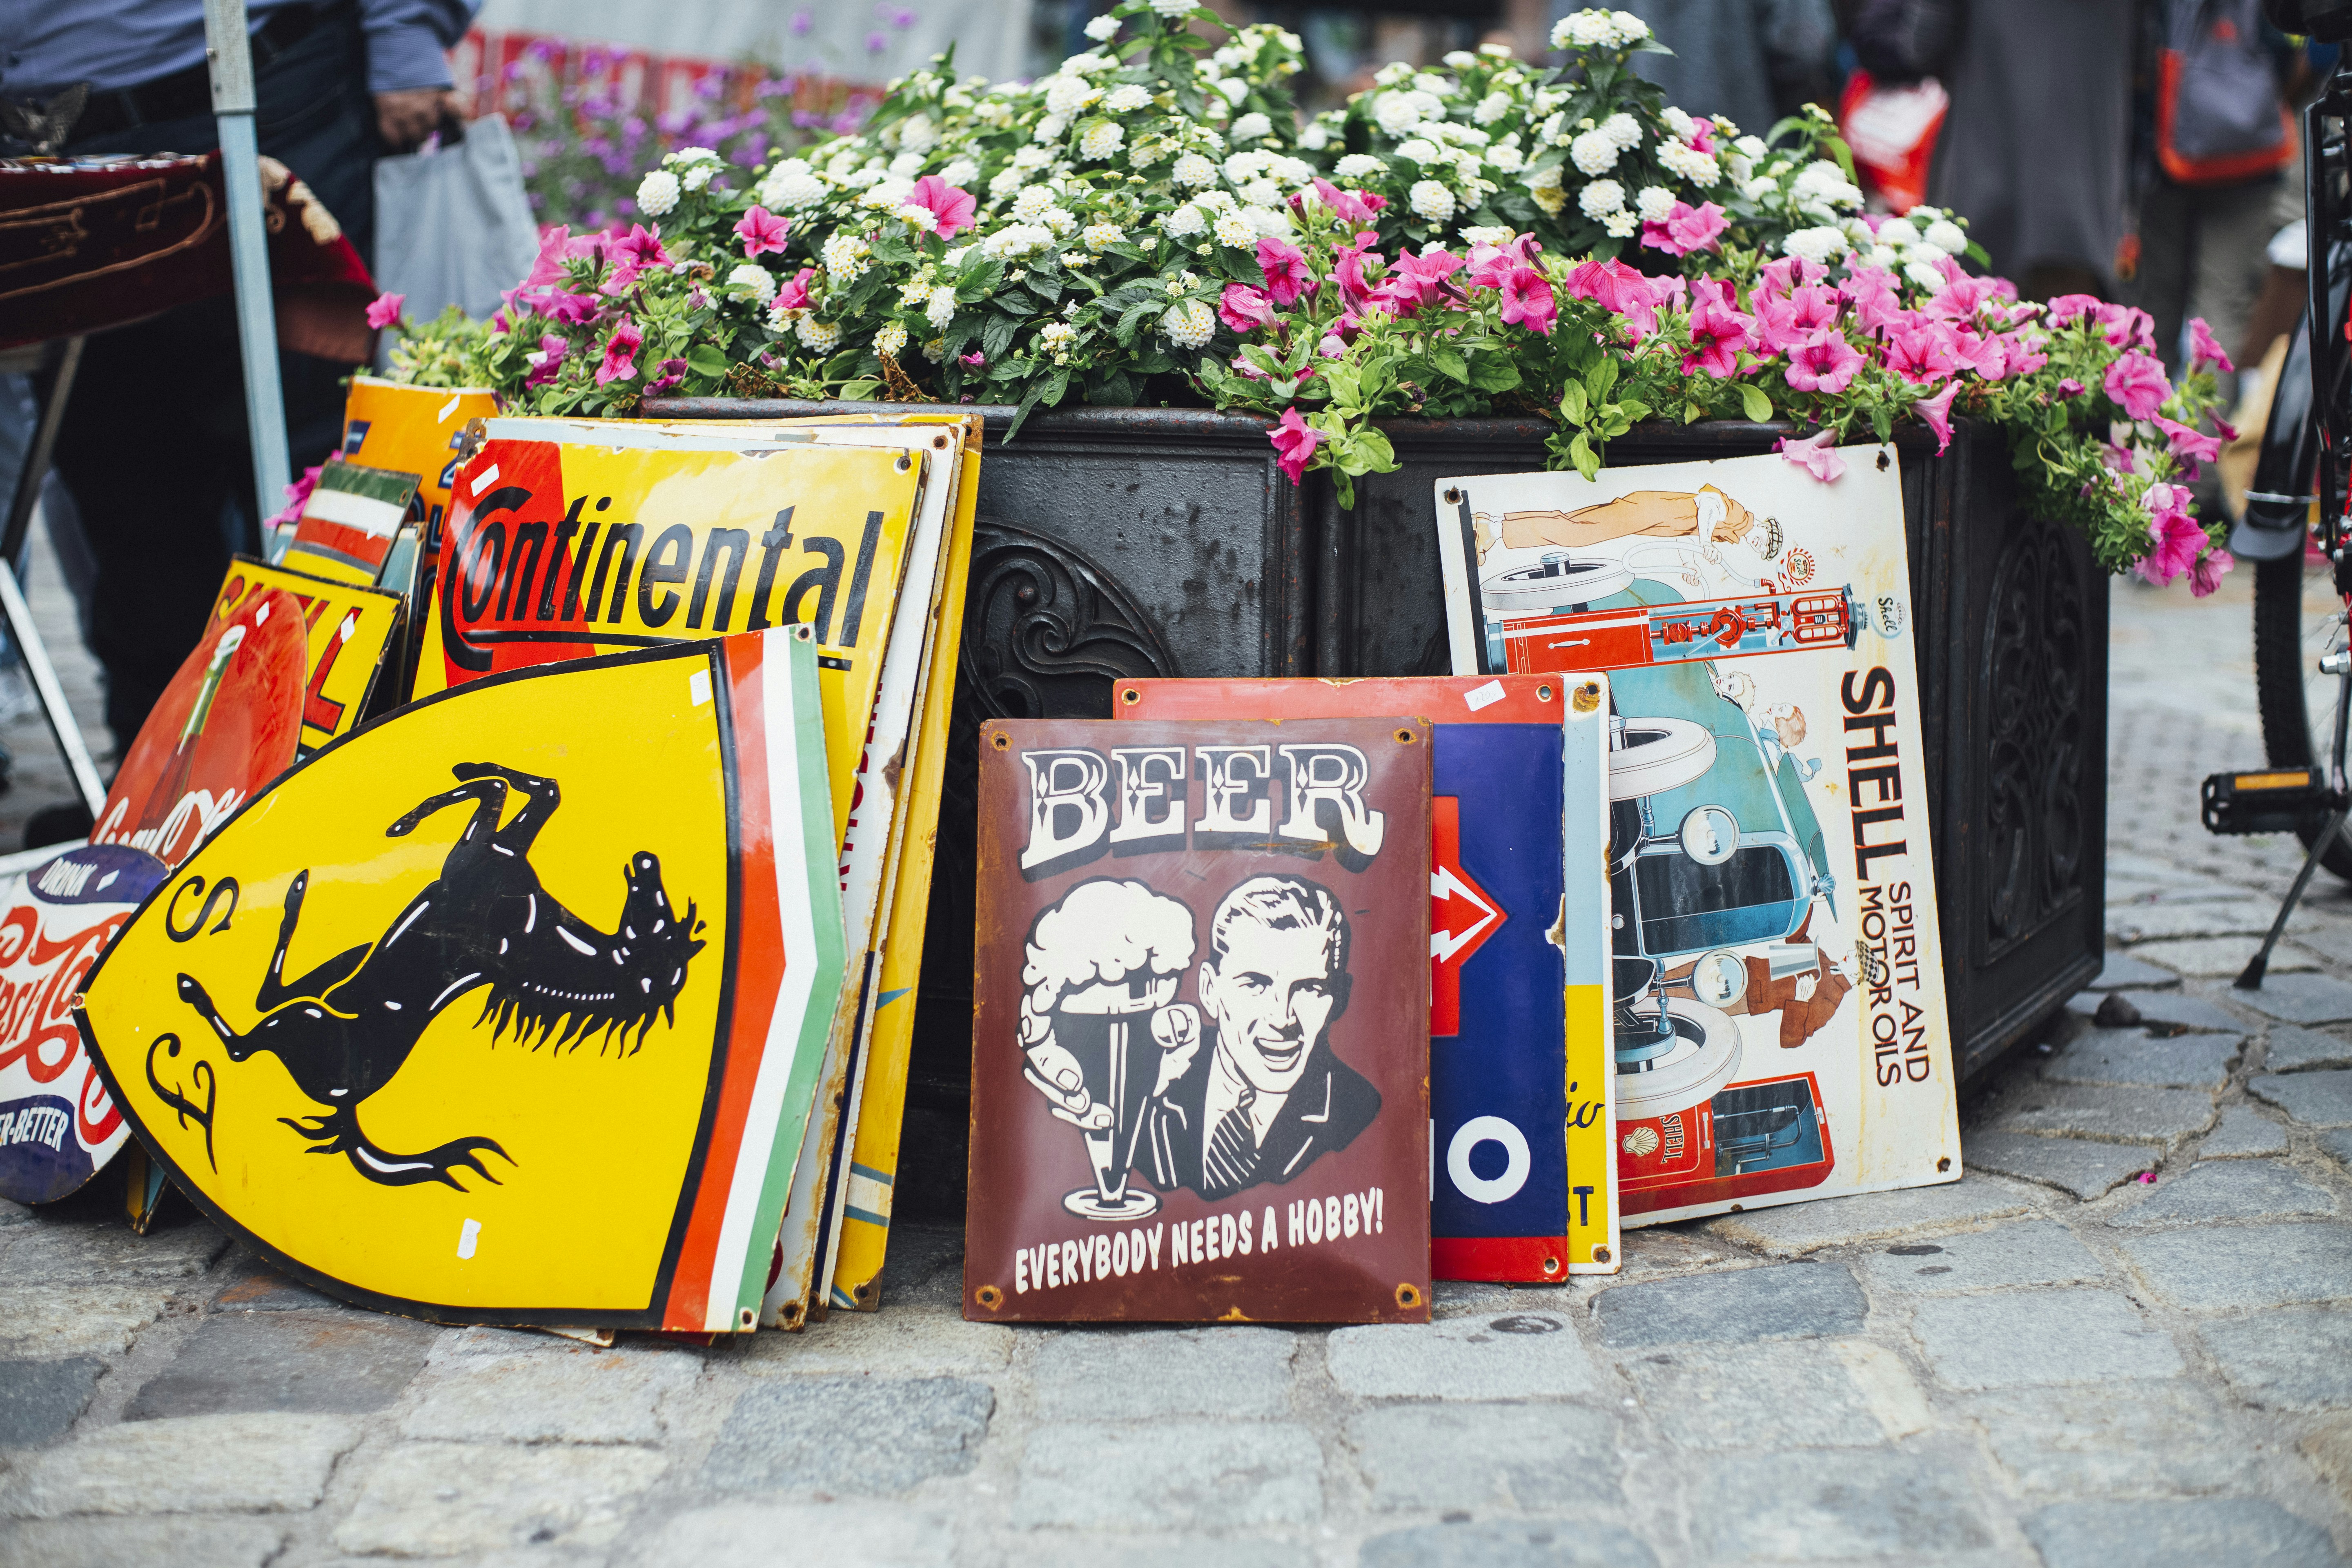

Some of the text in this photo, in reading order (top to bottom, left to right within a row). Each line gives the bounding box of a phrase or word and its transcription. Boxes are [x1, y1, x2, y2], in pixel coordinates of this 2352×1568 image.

[441, 486, 884, 672] Continental
[1878, 597, 1897, 632] Shell
[1021, 743, 1385, 870] BEER
[1840, 666, 1908, 881] SHELL
[37, 856, 98, 897] DRINK
[166, 875, 239, 942] S
[1859, 886, 1902, 1088] MOTOR OILS
[1889, 881, 1930, 1083] SPIRIT AND
[1659, 1114, 1684, 1164] SHELL
[1016, 1186, 1384, 1294] EVERYBODY NEEDS A HOBBY!
